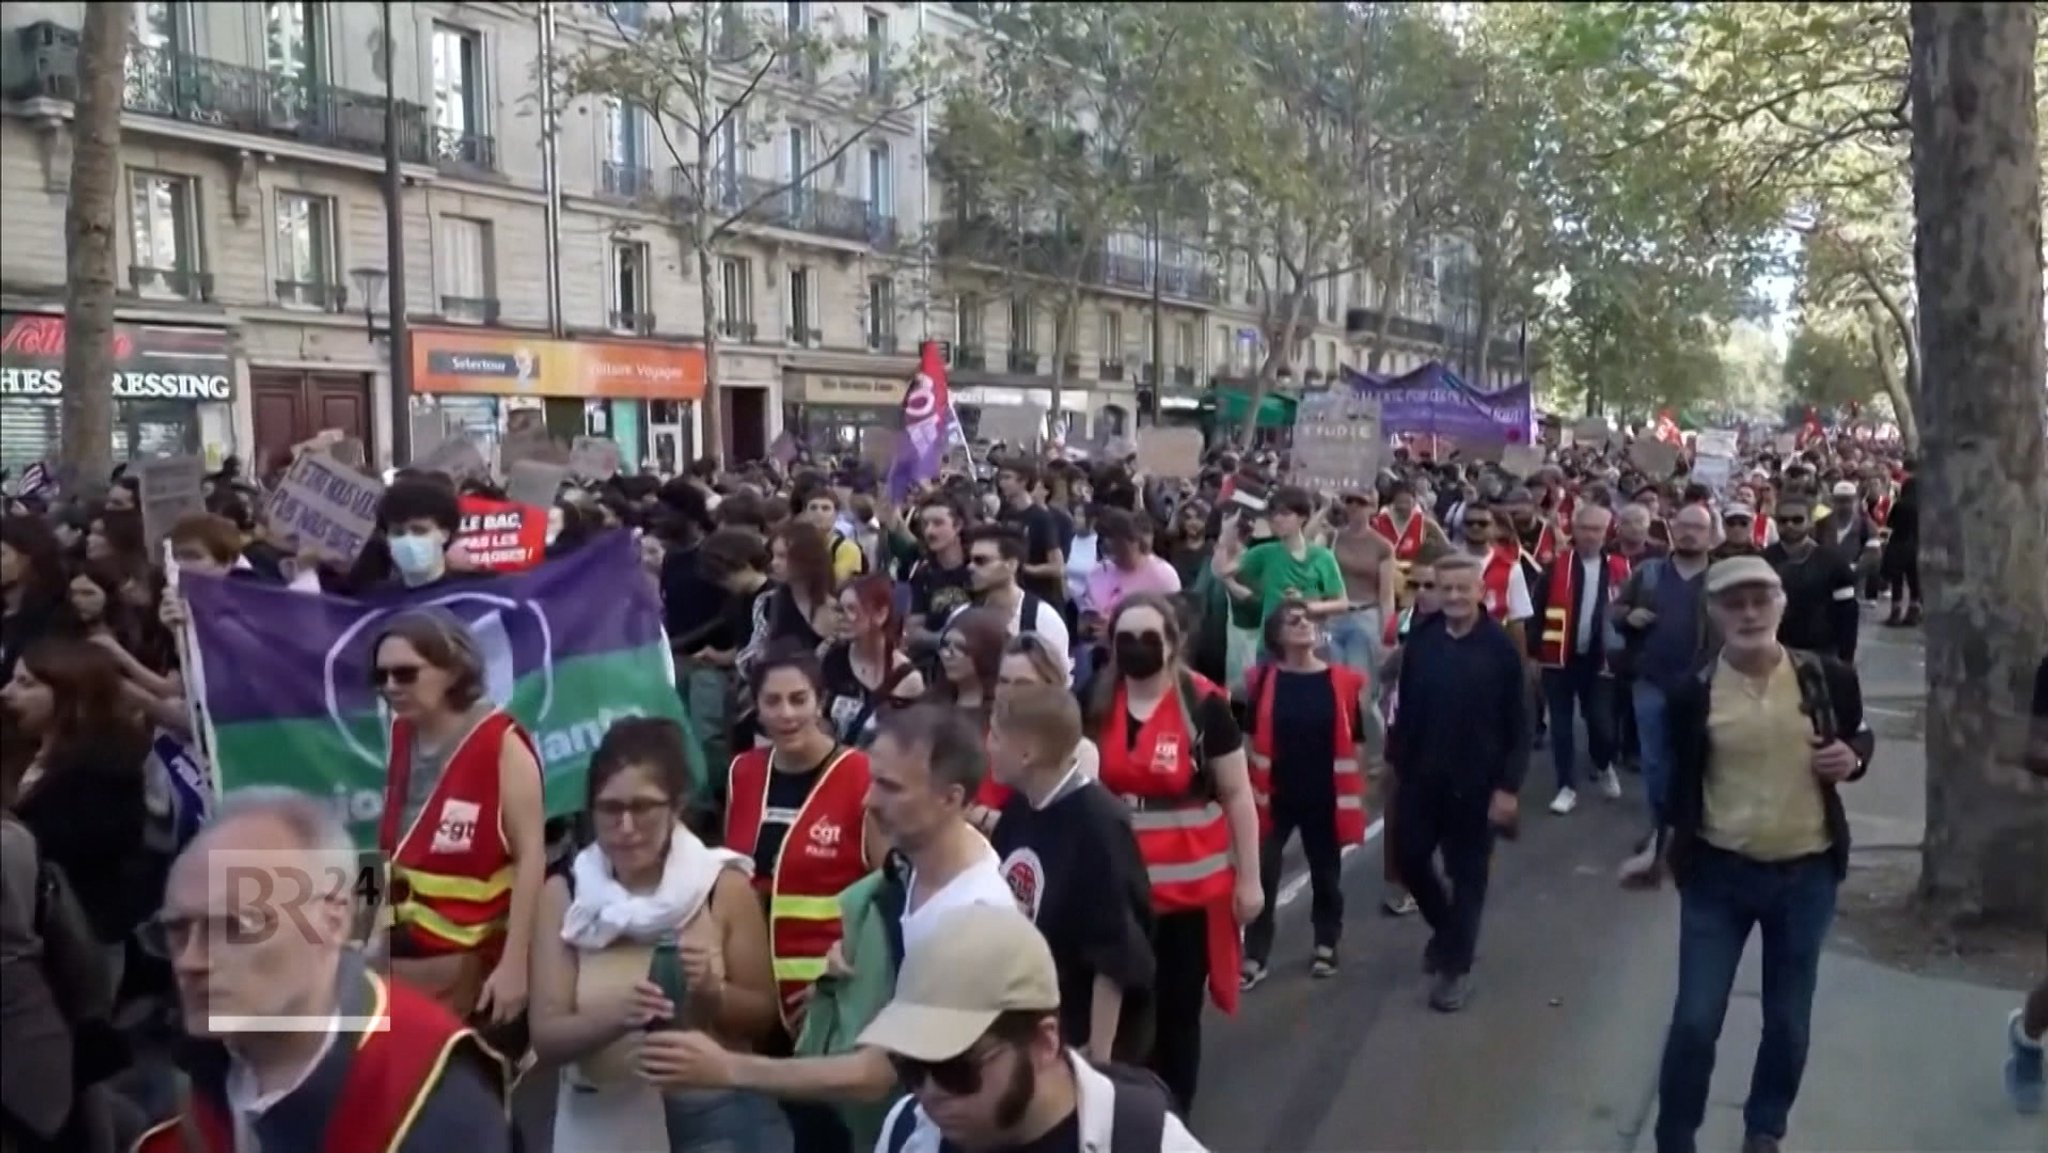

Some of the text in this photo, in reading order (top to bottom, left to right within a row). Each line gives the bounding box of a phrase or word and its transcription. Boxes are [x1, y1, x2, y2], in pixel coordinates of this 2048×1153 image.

[459, 514, 481, 532] LE
[438, 820, 474, 842] cgt
[809, 814, 841, 845] cgt
